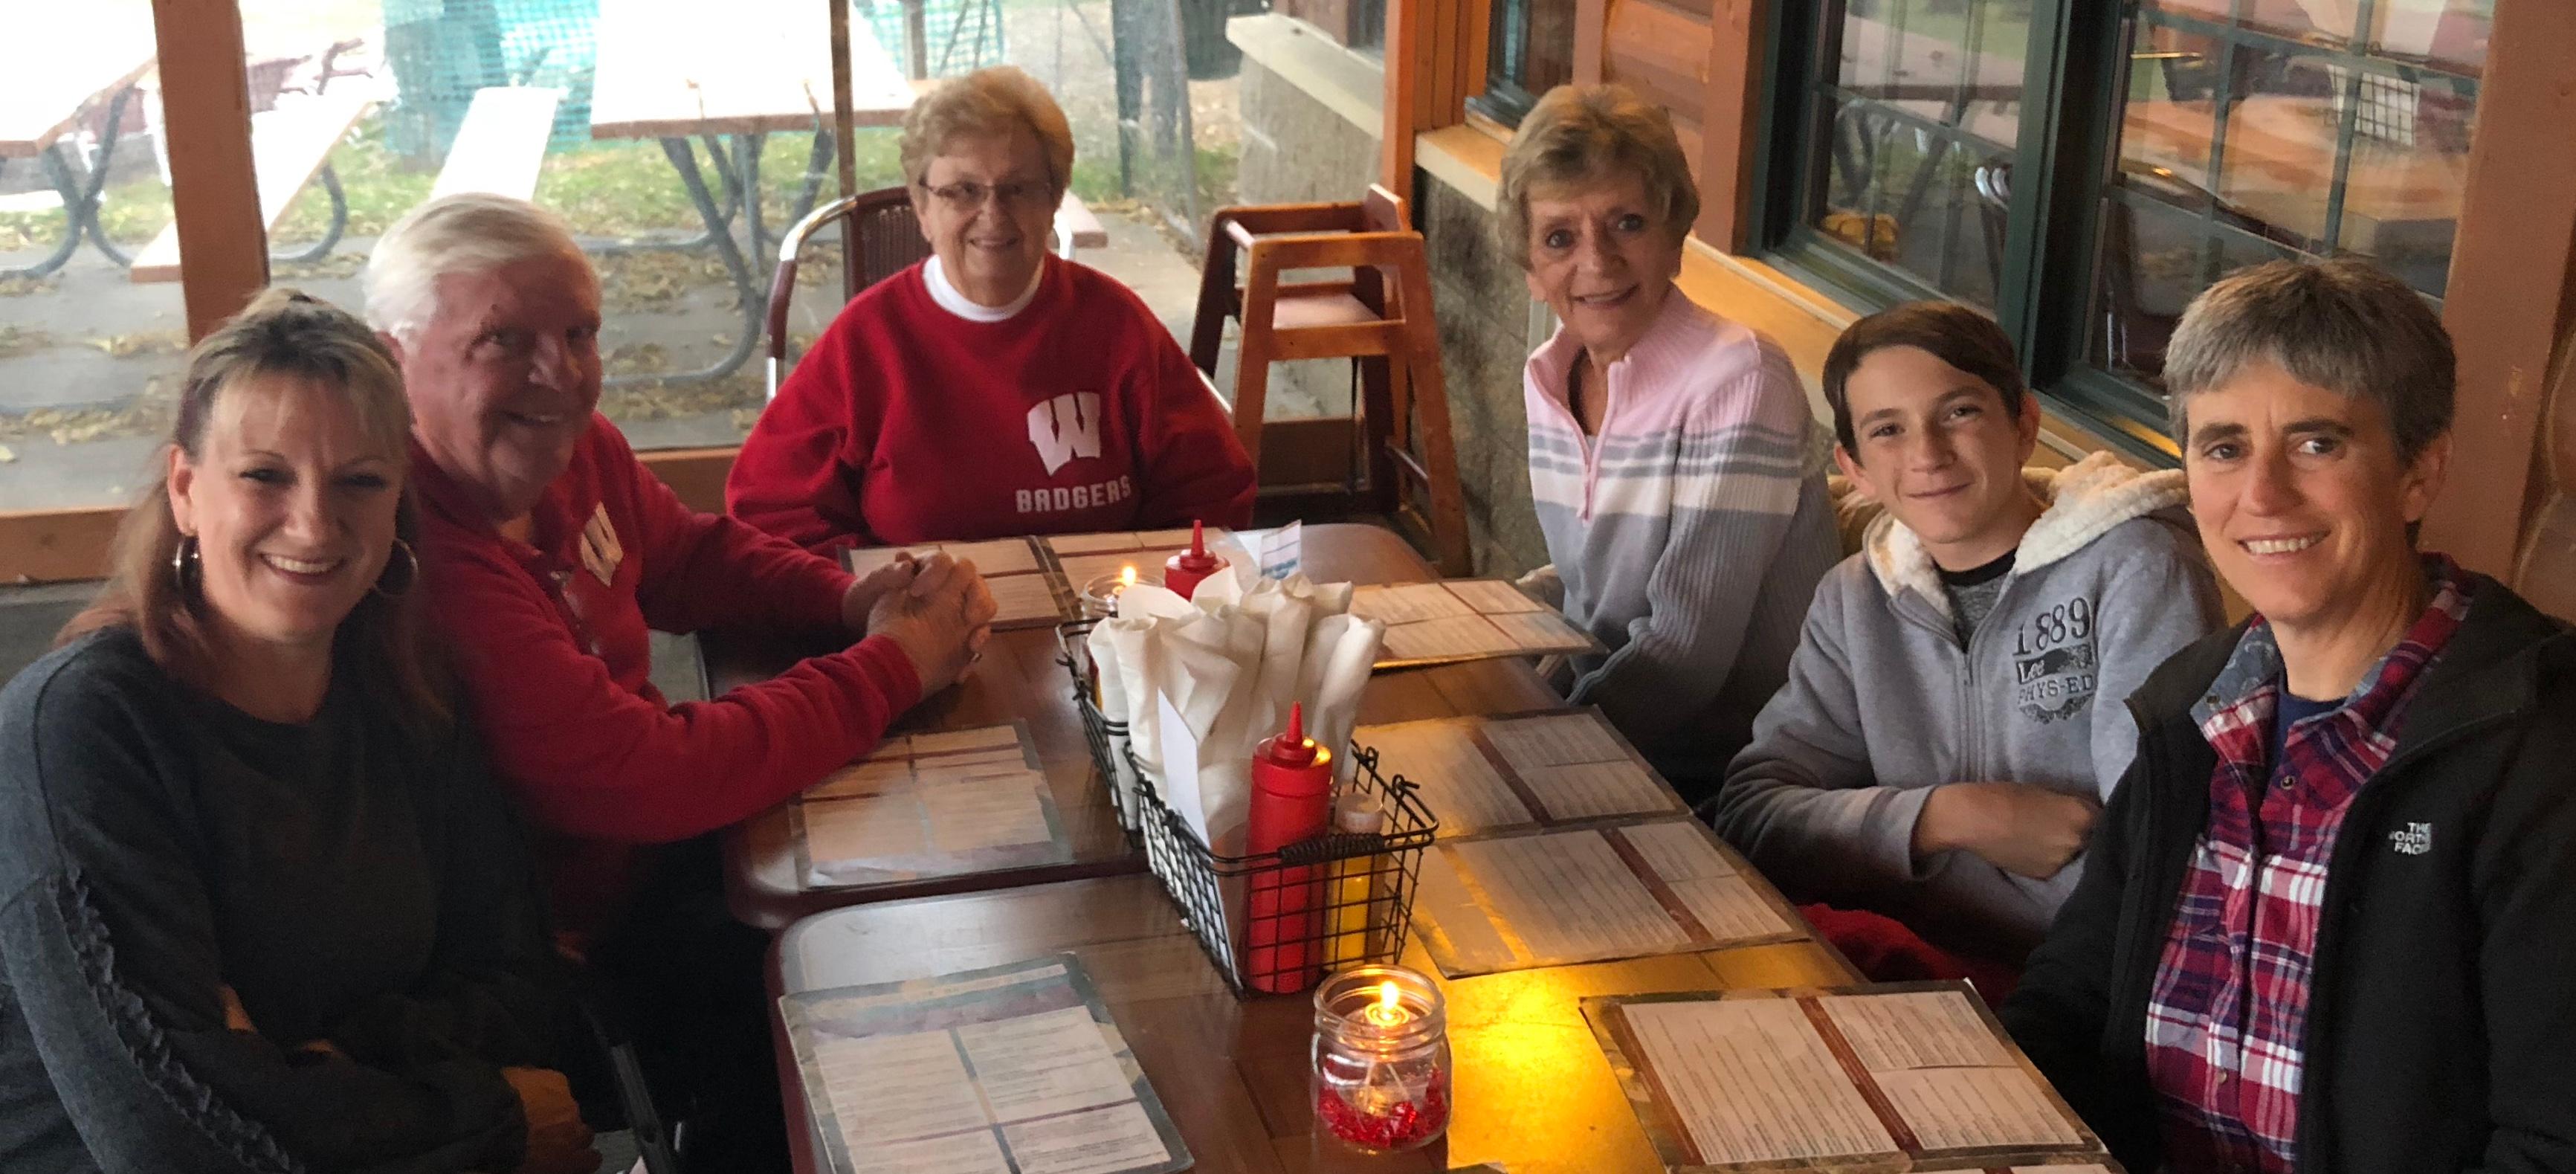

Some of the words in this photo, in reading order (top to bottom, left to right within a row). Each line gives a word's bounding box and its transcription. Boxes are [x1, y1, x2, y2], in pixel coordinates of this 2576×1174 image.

[1027, 391, 1100, 476] W
[1016, 475, 1132, 512] BADGERS
[580, 500, 623, 588] W
[2012, 597, 2091, 657] 1889
[2018, 674, 2094, 705] PHYS-ED
[2389, 830, 2429, 844] ORT
